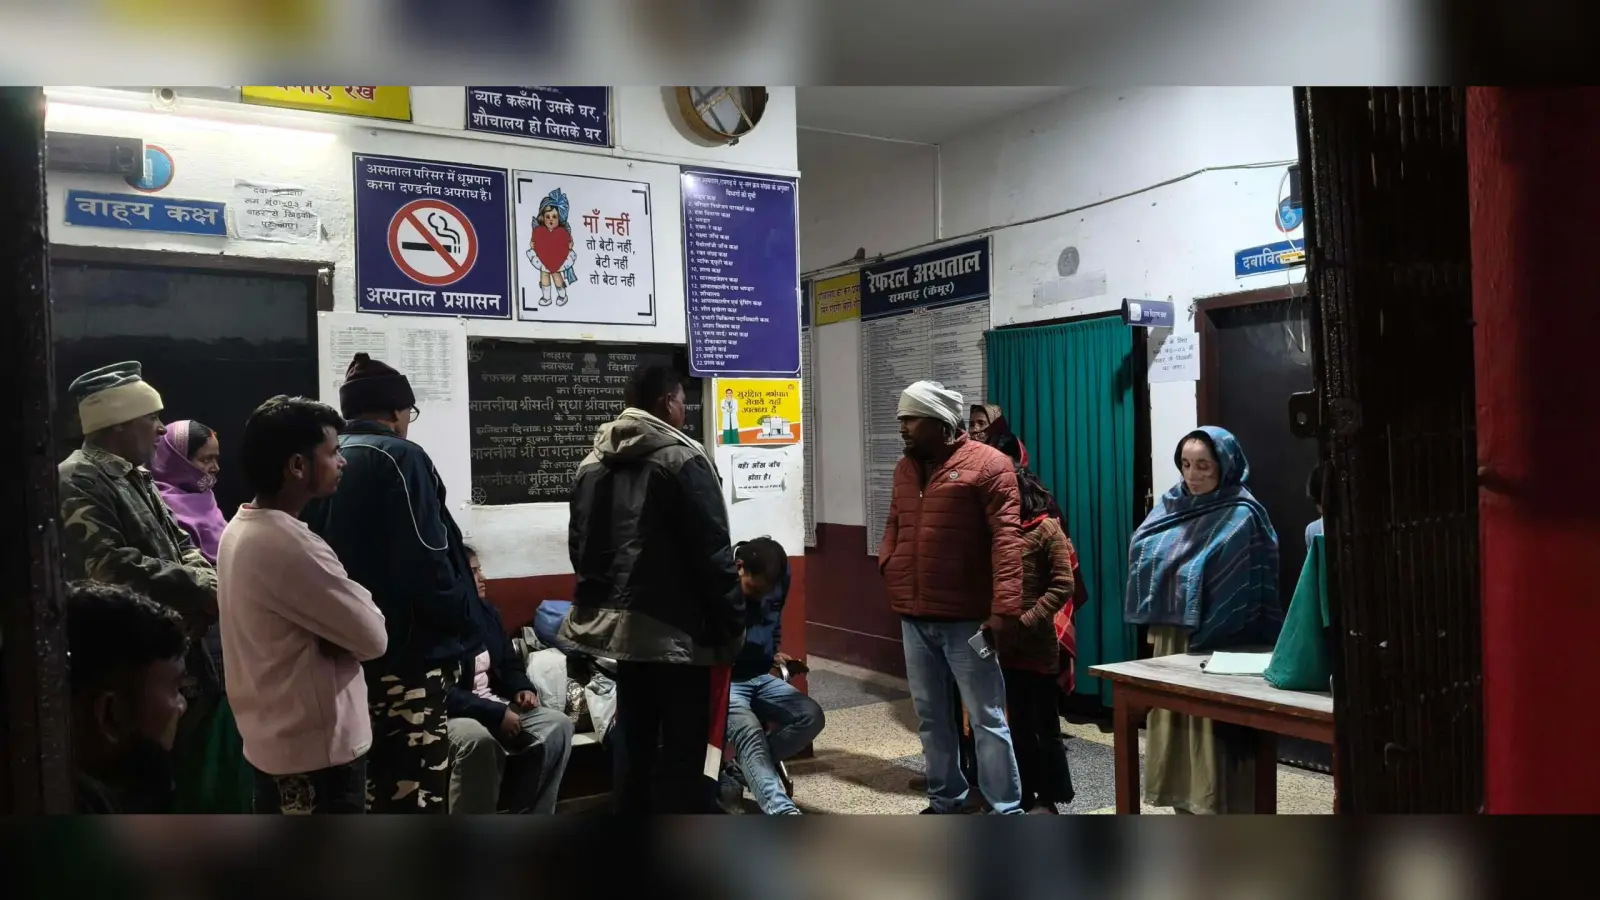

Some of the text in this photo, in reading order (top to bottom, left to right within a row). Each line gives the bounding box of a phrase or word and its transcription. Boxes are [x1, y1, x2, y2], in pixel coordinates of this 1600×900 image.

[546, 98, 575, 115] उसके
[578, 104, 600, 122] घर,
[472, 107, 602, 142] शौचालय हो जिसके घर
[366, 164, 492, 187] अस्पताल परिसर में धूम्रपान
[366, 180, 395, 191] करना
[399, 182, 442, 196] दण्डनीय
[444, 187, 478, 199] अपराध
[165, 204, 219, 226] कक्ष
[582, 208, 631, 236] माँ नहीं
[586, 236, 636, 255] तो बेटी नहीं,
[595, 253, 628, 270] बेटी नहीं
[865, 267, 909, 294] रेफरल
[913, 250, 982, 285] अस्पताल
[590, 270, 636, 287] तो बेटा नहीं
[366, 288, 502, 311] अस्पताल प्रशासन
[888, 290, 921, 303] रामगढ़
